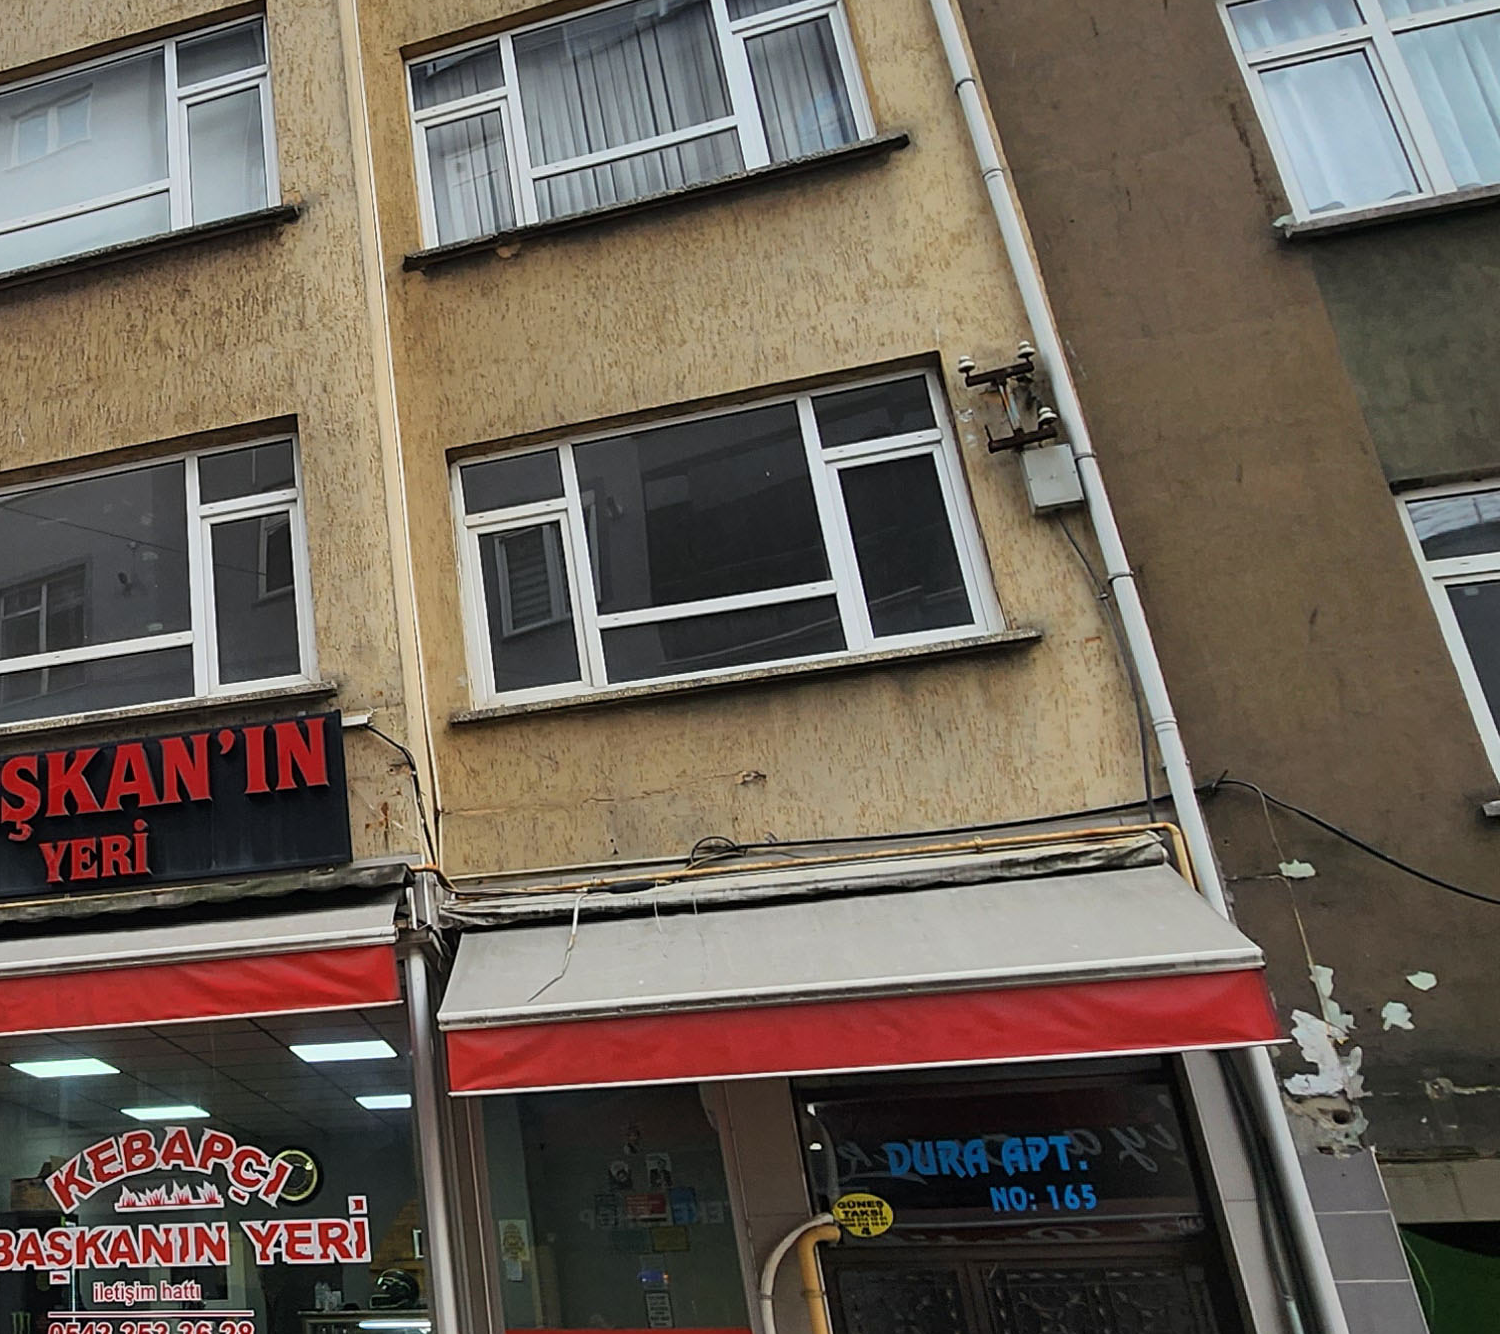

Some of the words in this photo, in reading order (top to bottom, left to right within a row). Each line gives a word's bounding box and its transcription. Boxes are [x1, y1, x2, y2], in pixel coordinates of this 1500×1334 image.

[39, 818, 153, 883] YERİ
[45, 1126, 294, 1215] KEBAPÇI
[884, 1138, 990, 1178] DURA
[1001, 1135, 1089, 1177] APT.
[1046, 1184, 1097, 1211] 165
[240, 1195, 372, 1266] YERİ
[92, 1279, 158, 1306] iletişim
[160, 1278, 202, 1303] hattı
